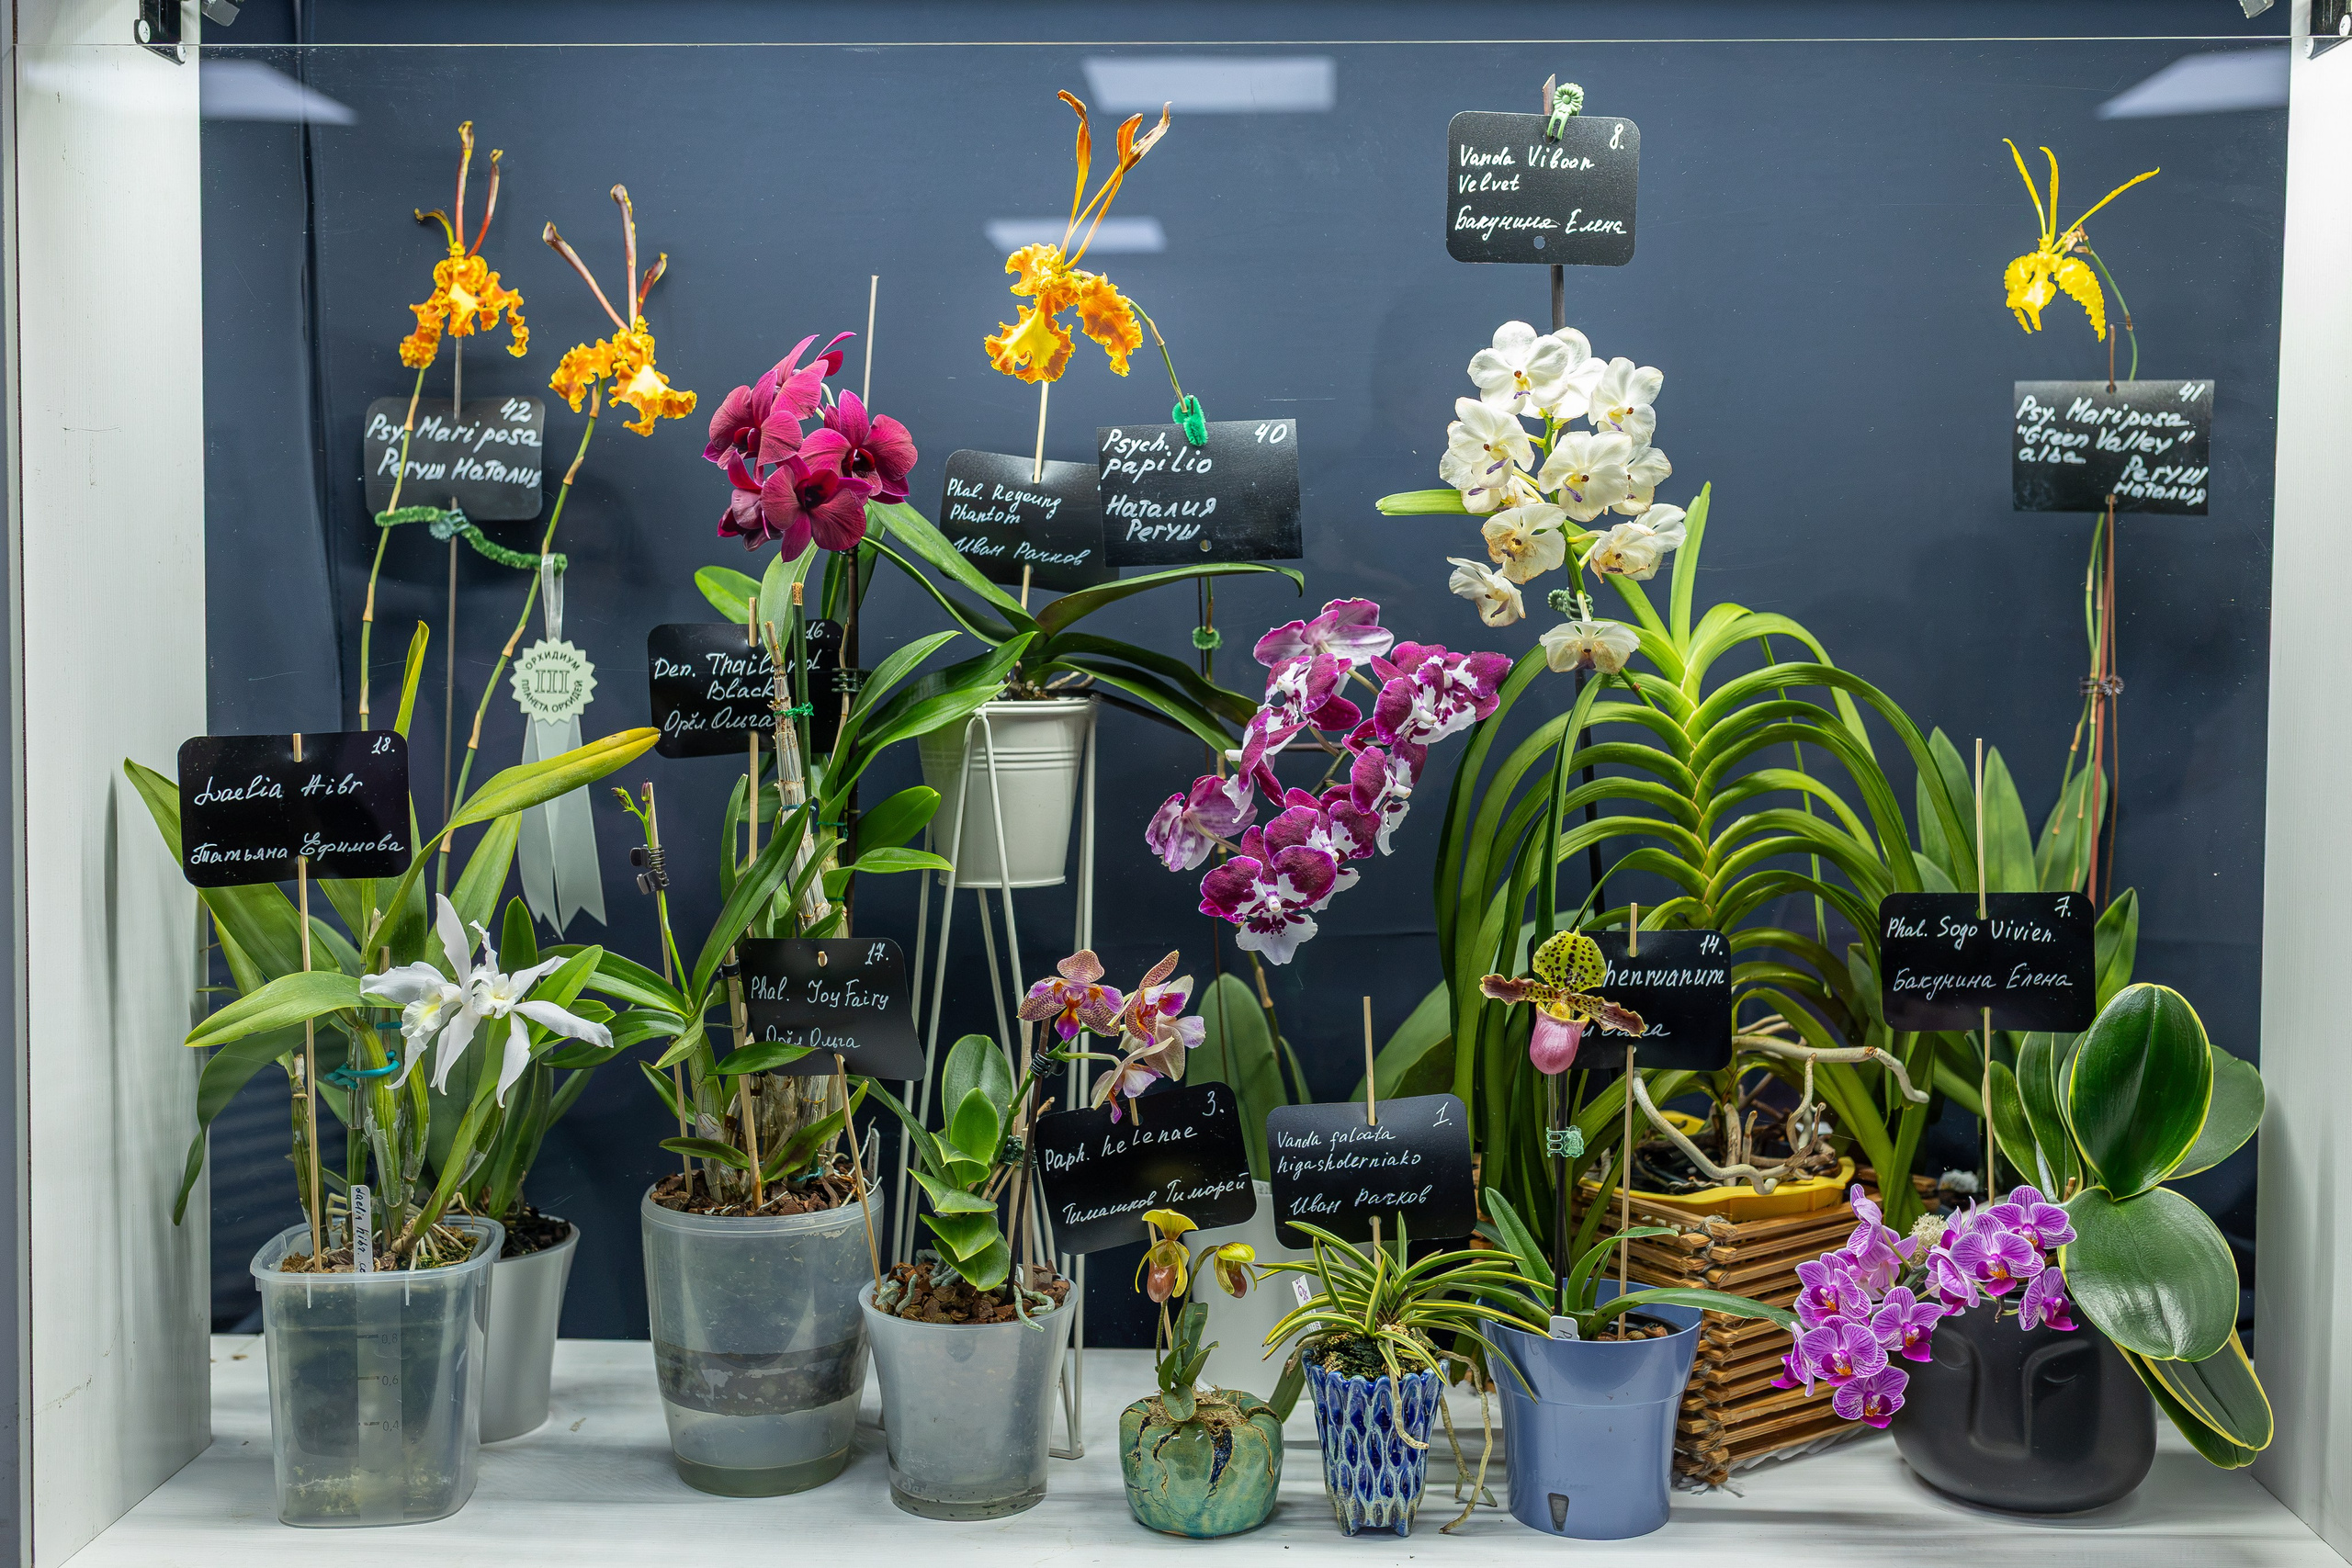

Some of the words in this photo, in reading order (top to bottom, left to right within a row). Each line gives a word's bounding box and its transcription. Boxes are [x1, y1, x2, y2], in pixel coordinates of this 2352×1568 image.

[1610, 123, 1624, 150] 8.
[1461, 144, 1516, 167] Vanda
[1459, 172, 1520, 194] Velvet
[1454, 205, 1558, 242] Бакунина
[1565, 209, 1627, 234] Елена
[2178, 381, 2206, 402] 41
[500, 398, 533, 423] 42
[2016, 394, 2055, 426] Psy.
[2065, 397, 2189, 432] Mariposa
[1102, 428, 1170, 459] Psych.
[1254, 423, 1287, 444] 40
[1101, 446, 1213, 484] papilio
[2018, 444, 2086, 464] alba
[947, 478, 983, 501] Phal.
[949, 502, 1021, 525] Phantom
[1106, 494, 1217, 518] Наталия
[1125, 519, 1201, 543] Регуш
[954, 536, 1005, 557] Иван
[526, 650, 581, 671] ОРХИДИУМ
[654, 658, 696, 680] Den.
[522, 679, 548, 713] ПЛАНЕТА
[551, 680, 583, 713] ОРХИДЕЙ
[707, 677, 775, 701] Black
[711, 705, 776, 729] Ольга
[371, 736, 396, 755] 18.
[190, 842, 288, 864] Татьяна
[300, 831, 404, 862] Ефимова
[2054, 896, 2071, 918] 7.
[1700, 934, 1724, 956] 14.
[1886, 916, 1928, 939] Phal.
[1937, 915, 1978, 951] Sogo
[865, 942, 889, 964] 17.
[751, 976, 790, 1002] Phal.
[1893, 967, 1996, 1001] Бакунина
[2006, 963, 2074, 989] Елена
[809, 1027, 861, 1048] Ольга
[1202, 1090, 1225, 1117] 3.
[1432, 1101, 1453, 1127] 1.
[1277, 1131, 1322, 1148] Vanda
[1045, 1142, 1091, 1172] Paph.
[1290, 1193, 1342, 1216] Иван
